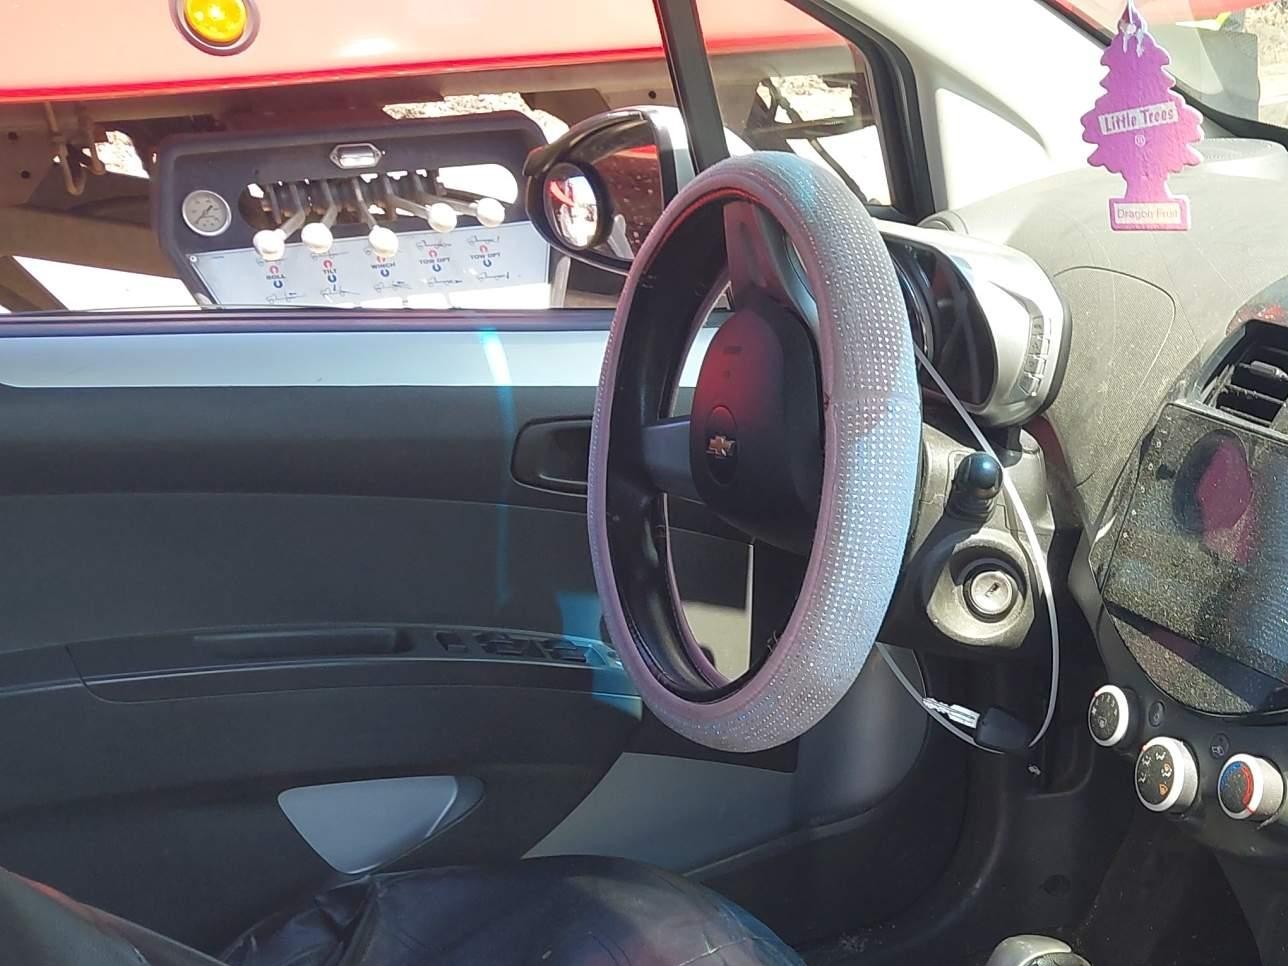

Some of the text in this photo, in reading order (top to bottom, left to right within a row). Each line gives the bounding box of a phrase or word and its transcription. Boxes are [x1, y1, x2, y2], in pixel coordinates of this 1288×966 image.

[1104, 109, 1174, 132] Little Trees
[1117, 207, 1153, 220] Dragon
